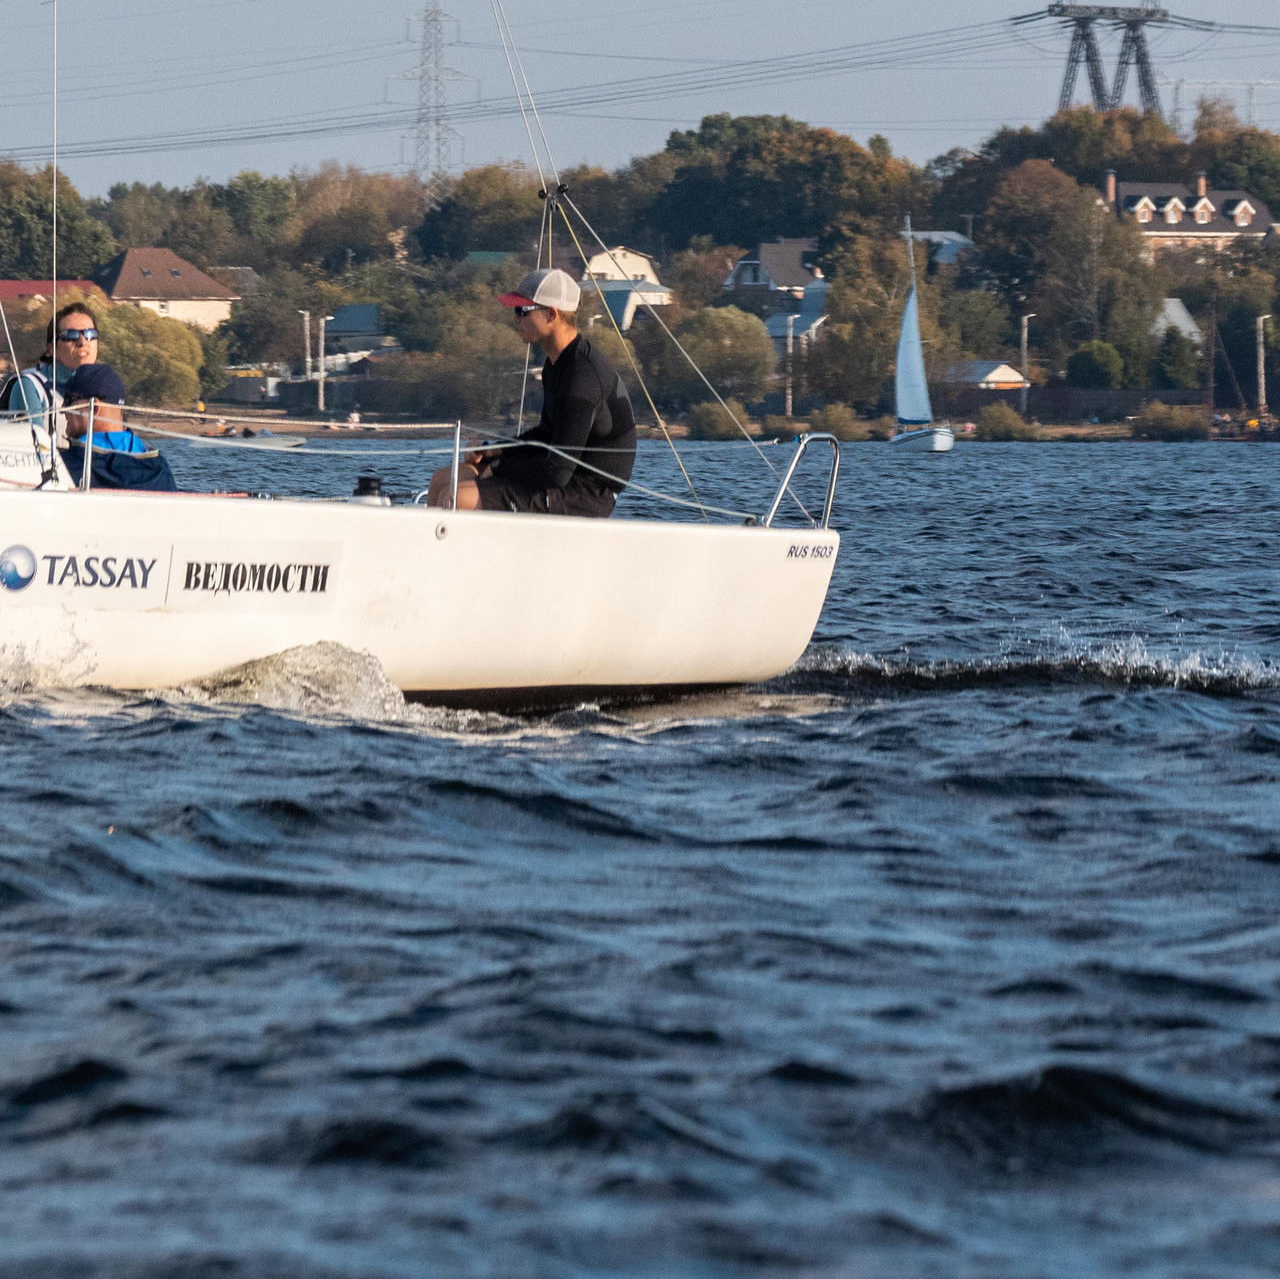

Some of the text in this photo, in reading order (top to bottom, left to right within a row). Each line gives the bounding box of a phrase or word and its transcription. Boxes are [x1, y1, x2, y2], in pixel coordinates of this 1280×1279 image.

[787, 545, 834, 558] RUS 1503
[42, 554, 157, 589] TASSAY
[183, 560, 330, 597] ВЕДОМОСТИ
